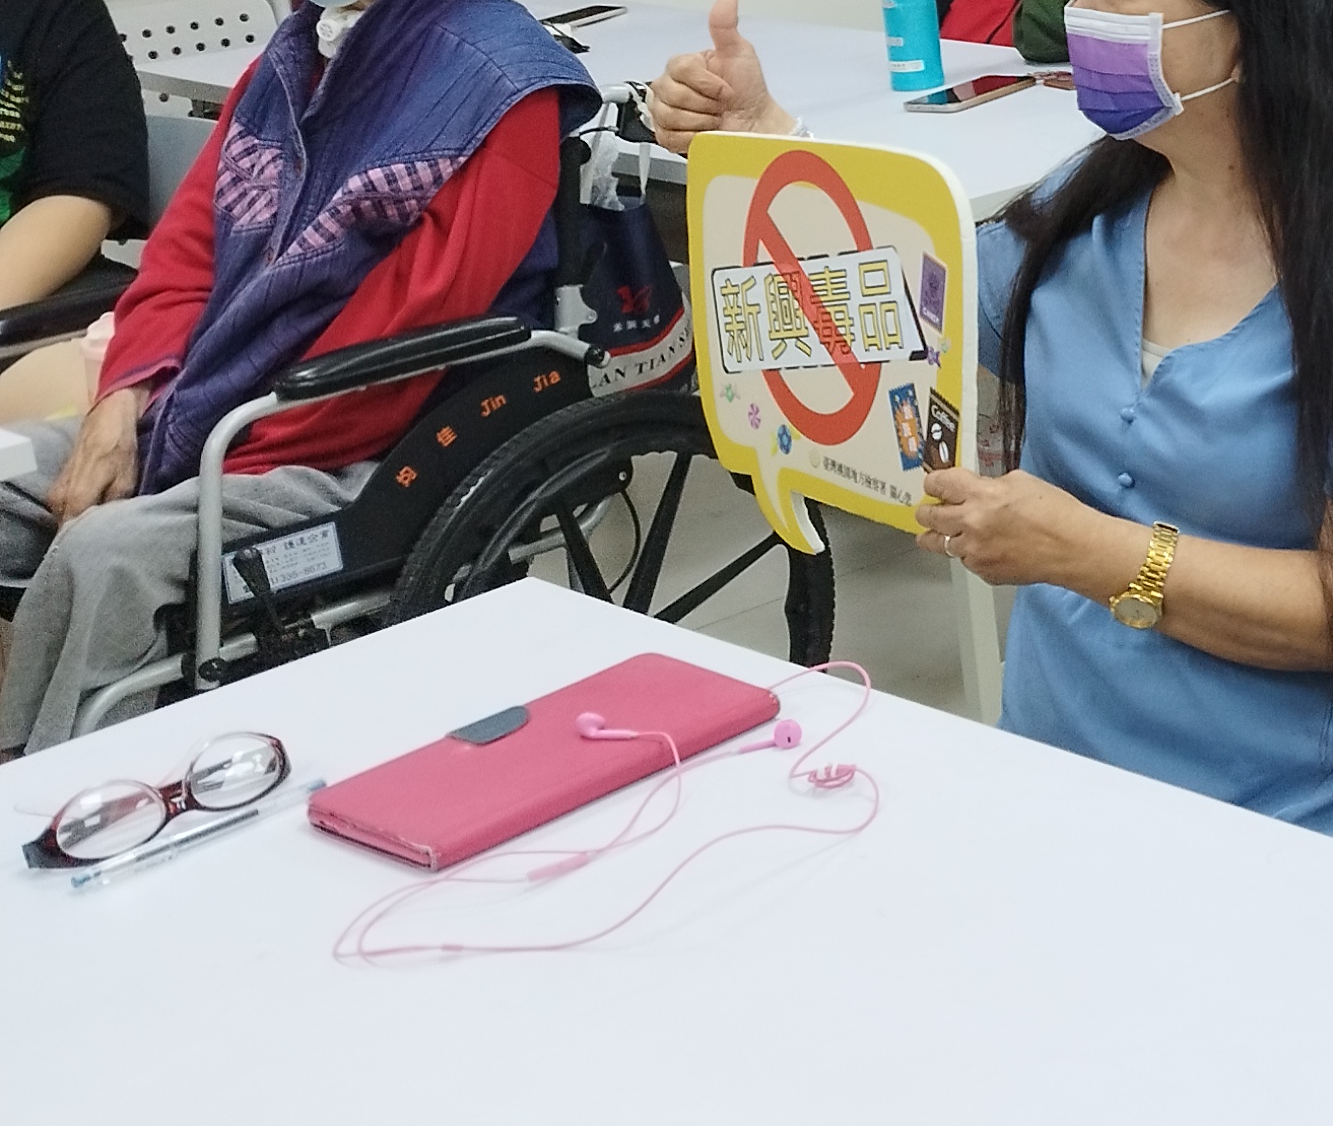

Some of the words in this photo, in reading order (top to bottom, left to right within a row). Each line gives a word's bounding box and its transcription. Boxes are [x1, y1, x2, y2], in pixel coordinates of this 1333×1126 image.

[719, 260, 905, 364] 新興毒品
[532, 370, 561, 393] Jia
